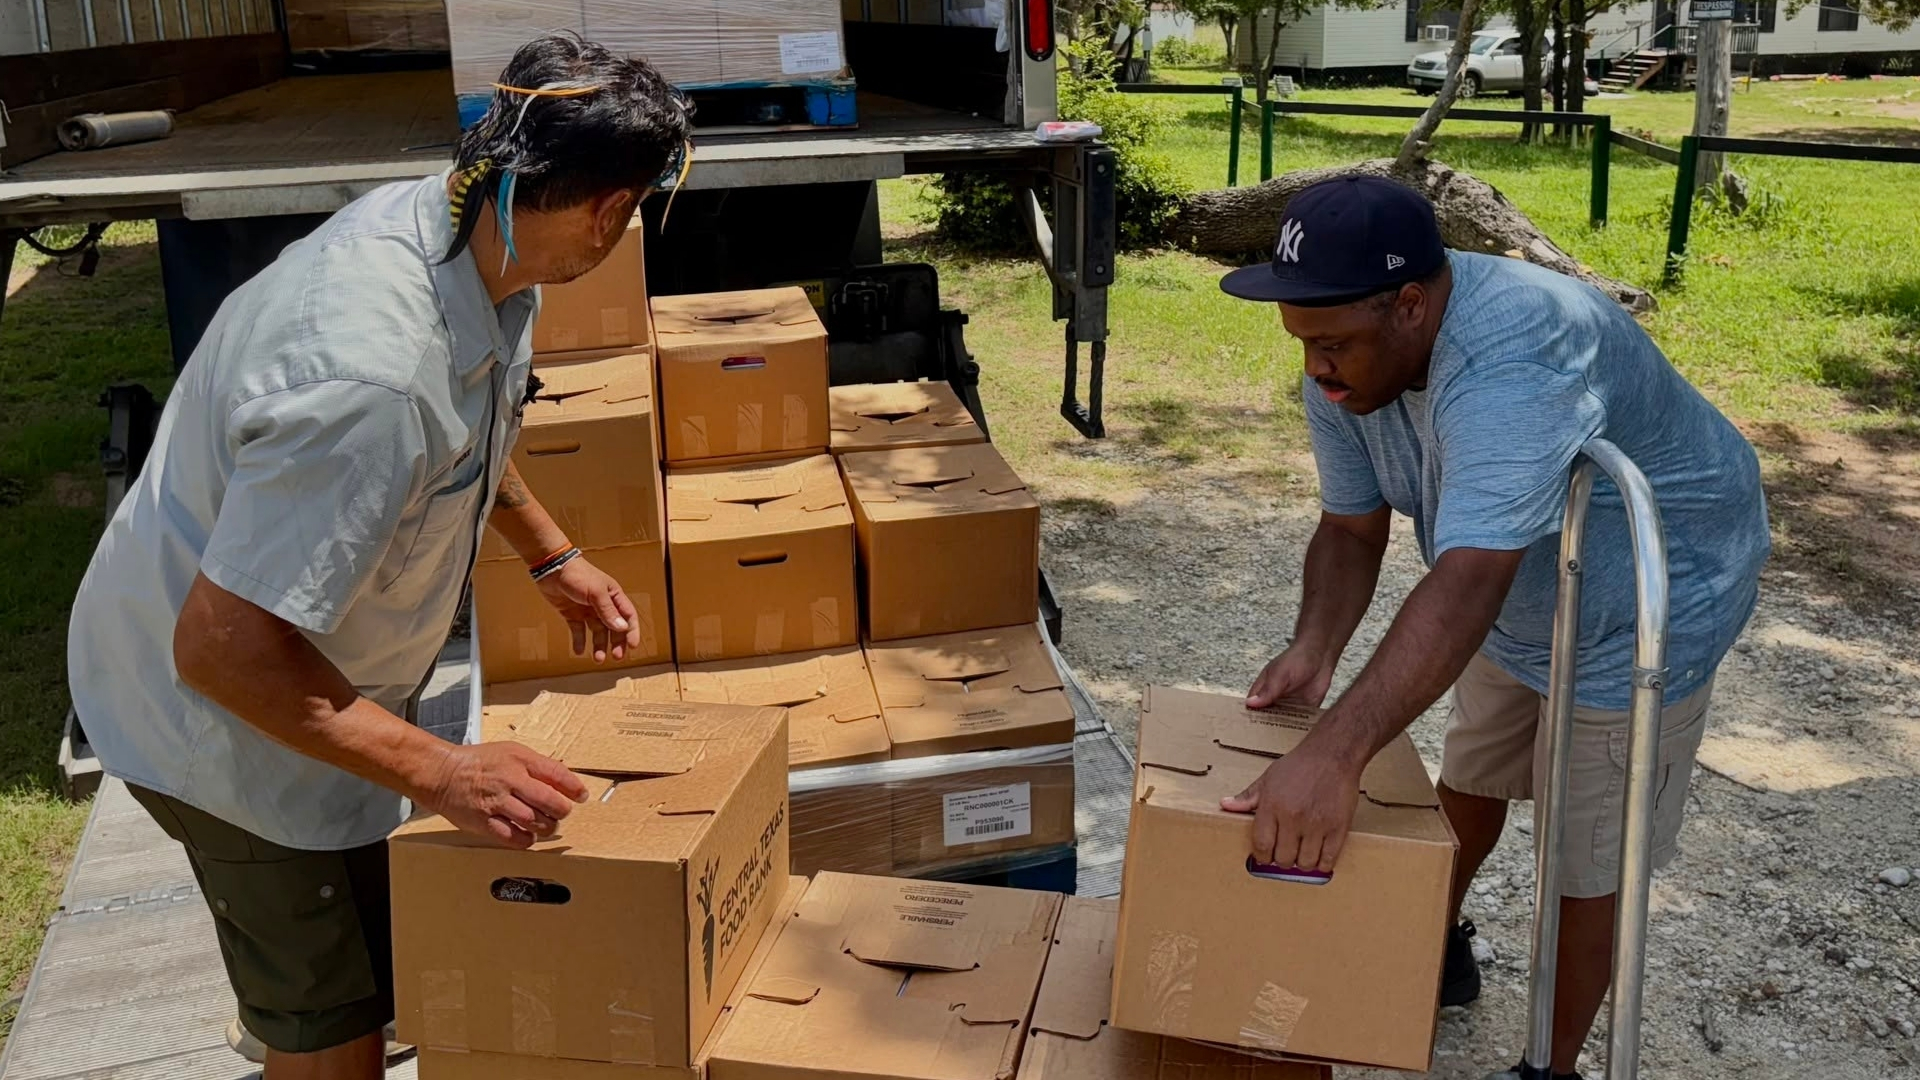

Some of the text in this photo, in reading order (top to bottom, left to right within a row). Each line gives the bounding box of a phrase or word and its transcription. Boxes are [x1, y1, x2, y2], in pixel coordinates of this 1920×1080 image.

[1276, 217, 1305, 263] NY
[719, 847, 759, 926] CENTRAL
[759, 801, 784, 850] TEXAS
[720, 896, 747, 959] FOOD
[749, 849, 773, 907] BANK
[899, 914, 955, 926] PERISHABLE
[904, 894, 964, 906] PERECEDERO
